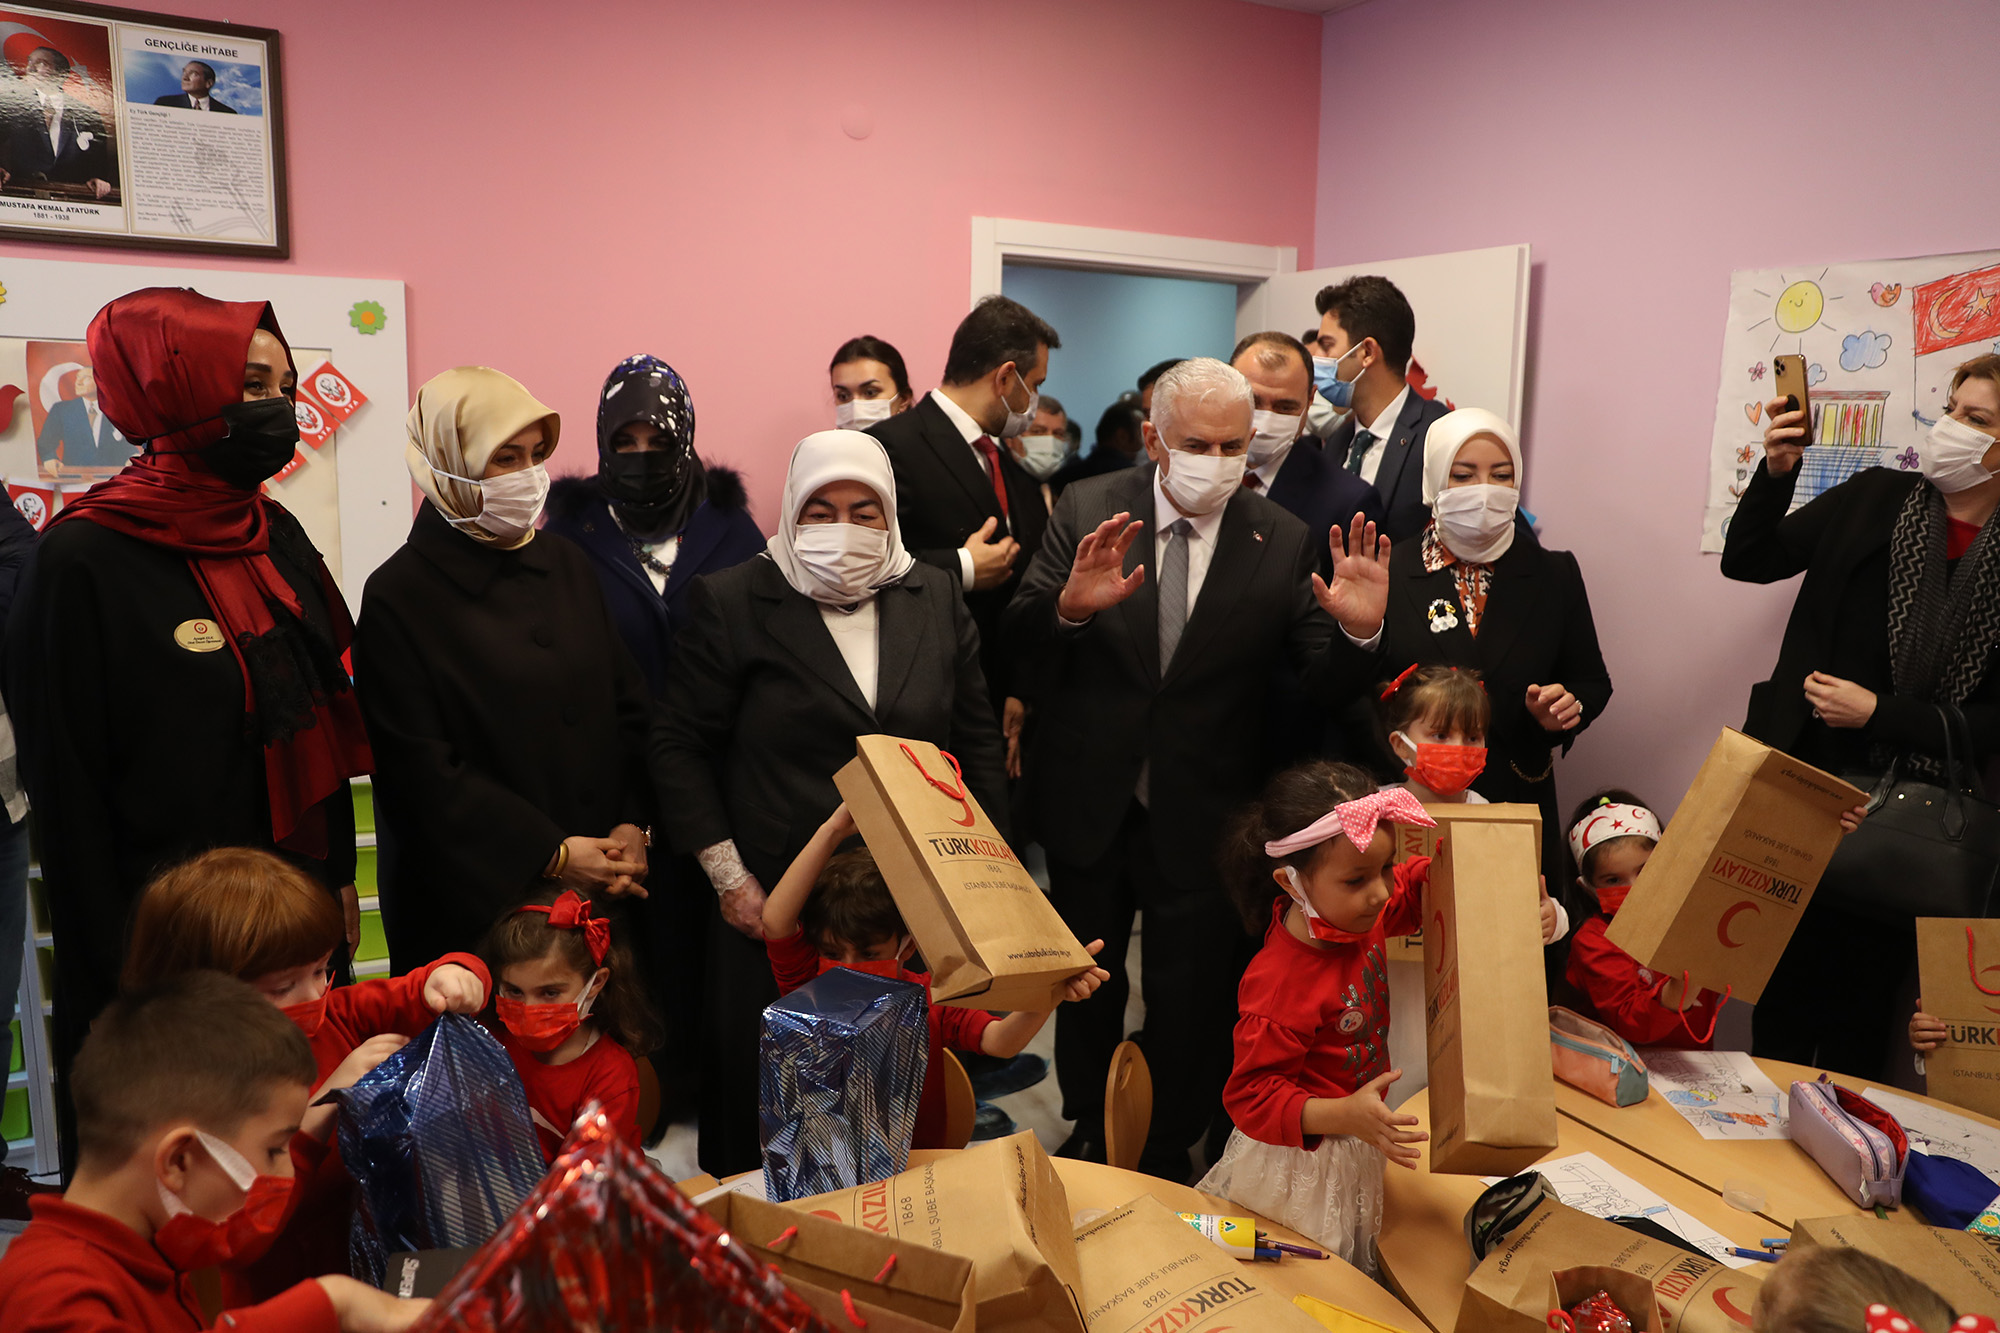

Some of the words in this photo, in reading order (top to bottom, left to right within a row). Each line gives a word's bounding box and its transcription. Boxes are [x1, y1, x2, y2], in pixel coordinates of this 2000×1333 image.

[144, 38, 199, 53] GENÇLİĞE
[201, 45, 239, 58] HİTABE
[0, 201, 36, 210] MUSTAFA
[37, 205, 64, 213] KEMAL
[66, 207, 100, 216] ATATÜRK
[344, 399, 359, 414] ATA
[317, 426, 332, 441] ATA
[900, 1196, 915, 1226] 1868
[926, 1197, 941, 1226] ŞUBE
[1158, 1252, 1203, 1276] İSTANBUL
[1134, 1271, 1160, 1290] ŞUBE
[1142, 1288, 1172, 1309] 1868
